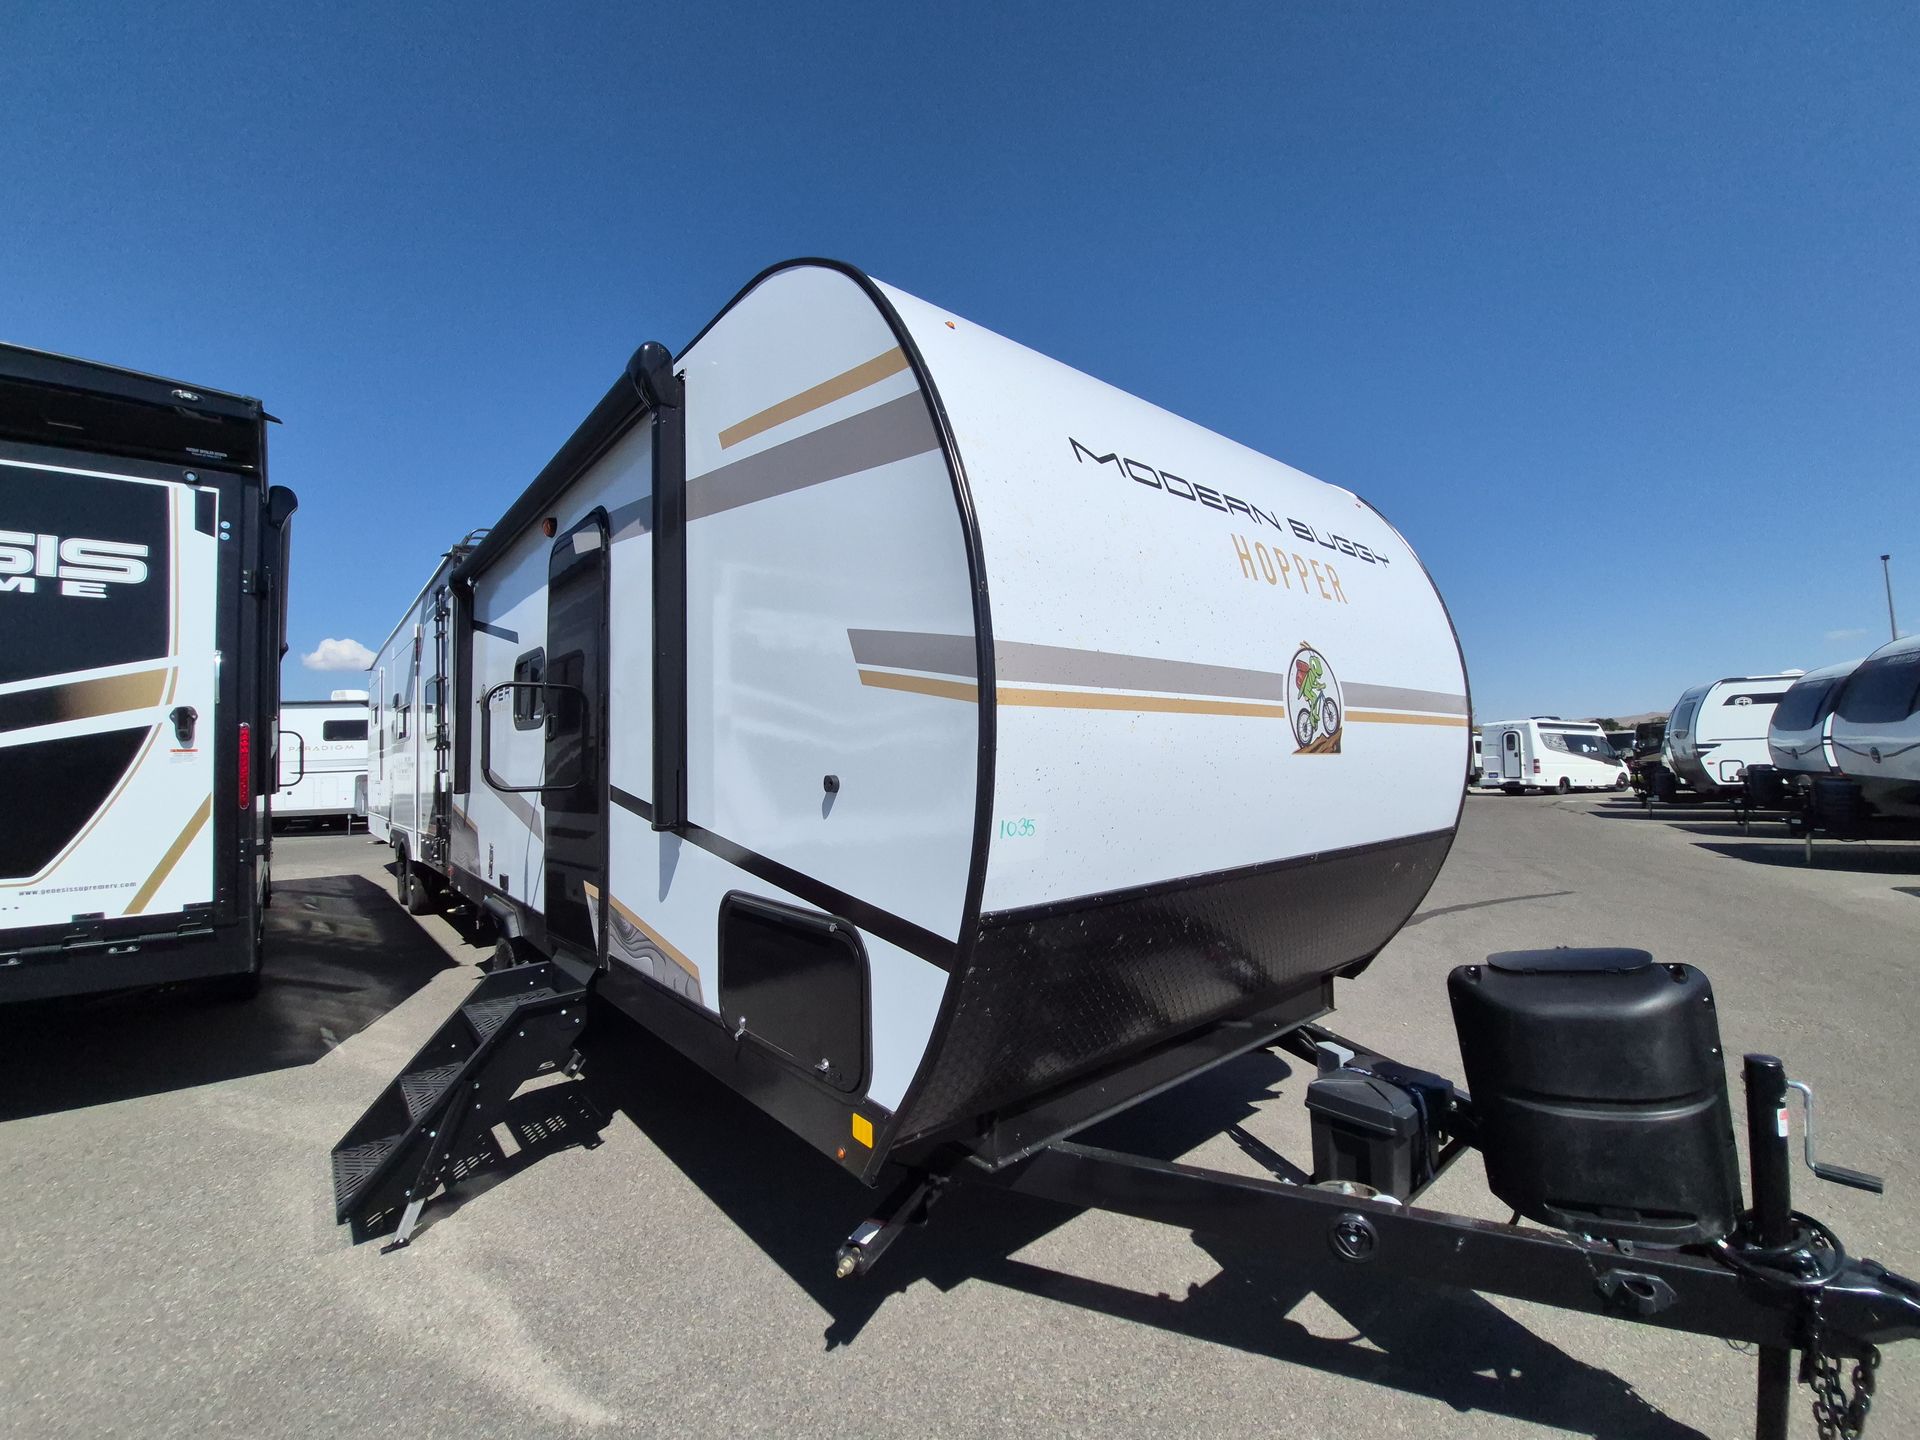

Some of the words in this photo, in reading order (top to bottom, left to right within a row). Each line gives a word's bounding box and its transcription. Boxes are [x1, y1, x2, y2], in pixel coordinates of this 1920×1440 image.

[1069, 436, 1282, 532] MODERN
[1287, 517, 1390, 568] BUGGY
[1231, 533, 1348, 604] HOPPER
[288, 743, 354, 752] PARADIGM
[1000, 817, 1036, 839] 1035
